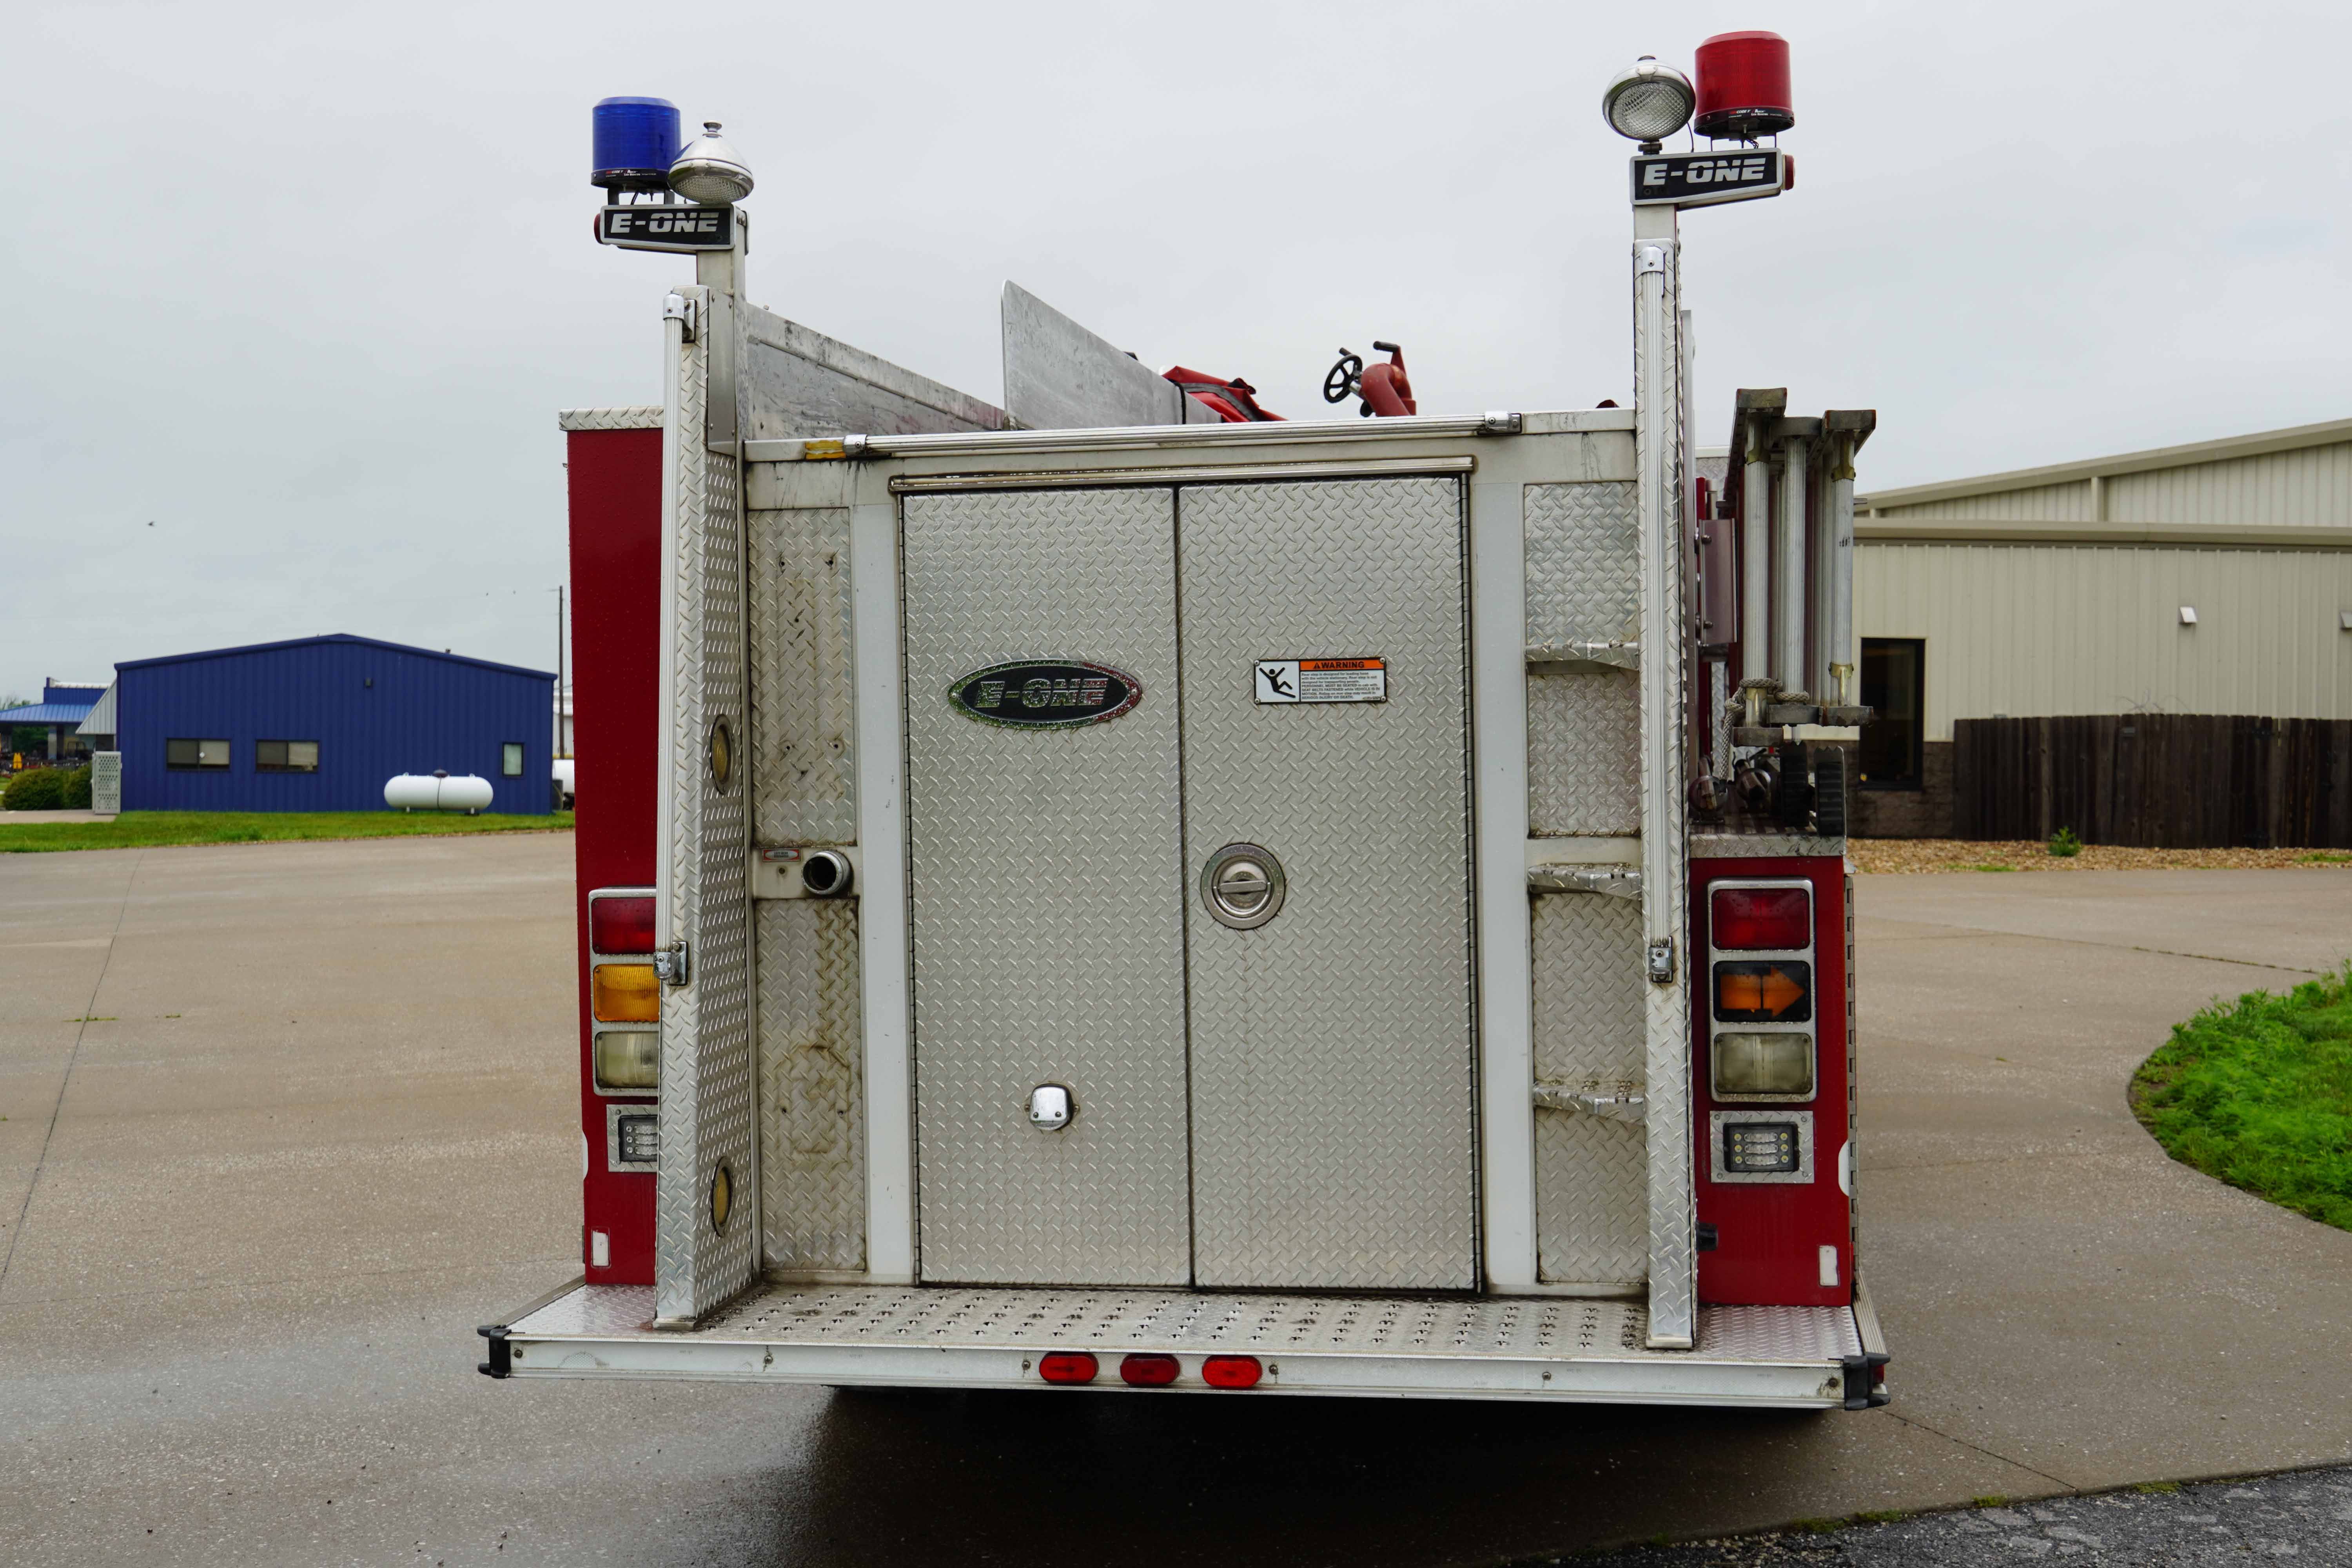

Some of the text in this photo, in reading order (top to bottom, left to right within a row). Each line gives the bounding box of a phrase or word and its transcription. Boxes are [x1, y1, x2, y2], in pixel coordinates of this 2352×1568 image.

[1643, 158, 1766, 186] E-ONE
[610, 212, 719, 233] E-ONE
[975, 678, 1108, 707] E-ONE
